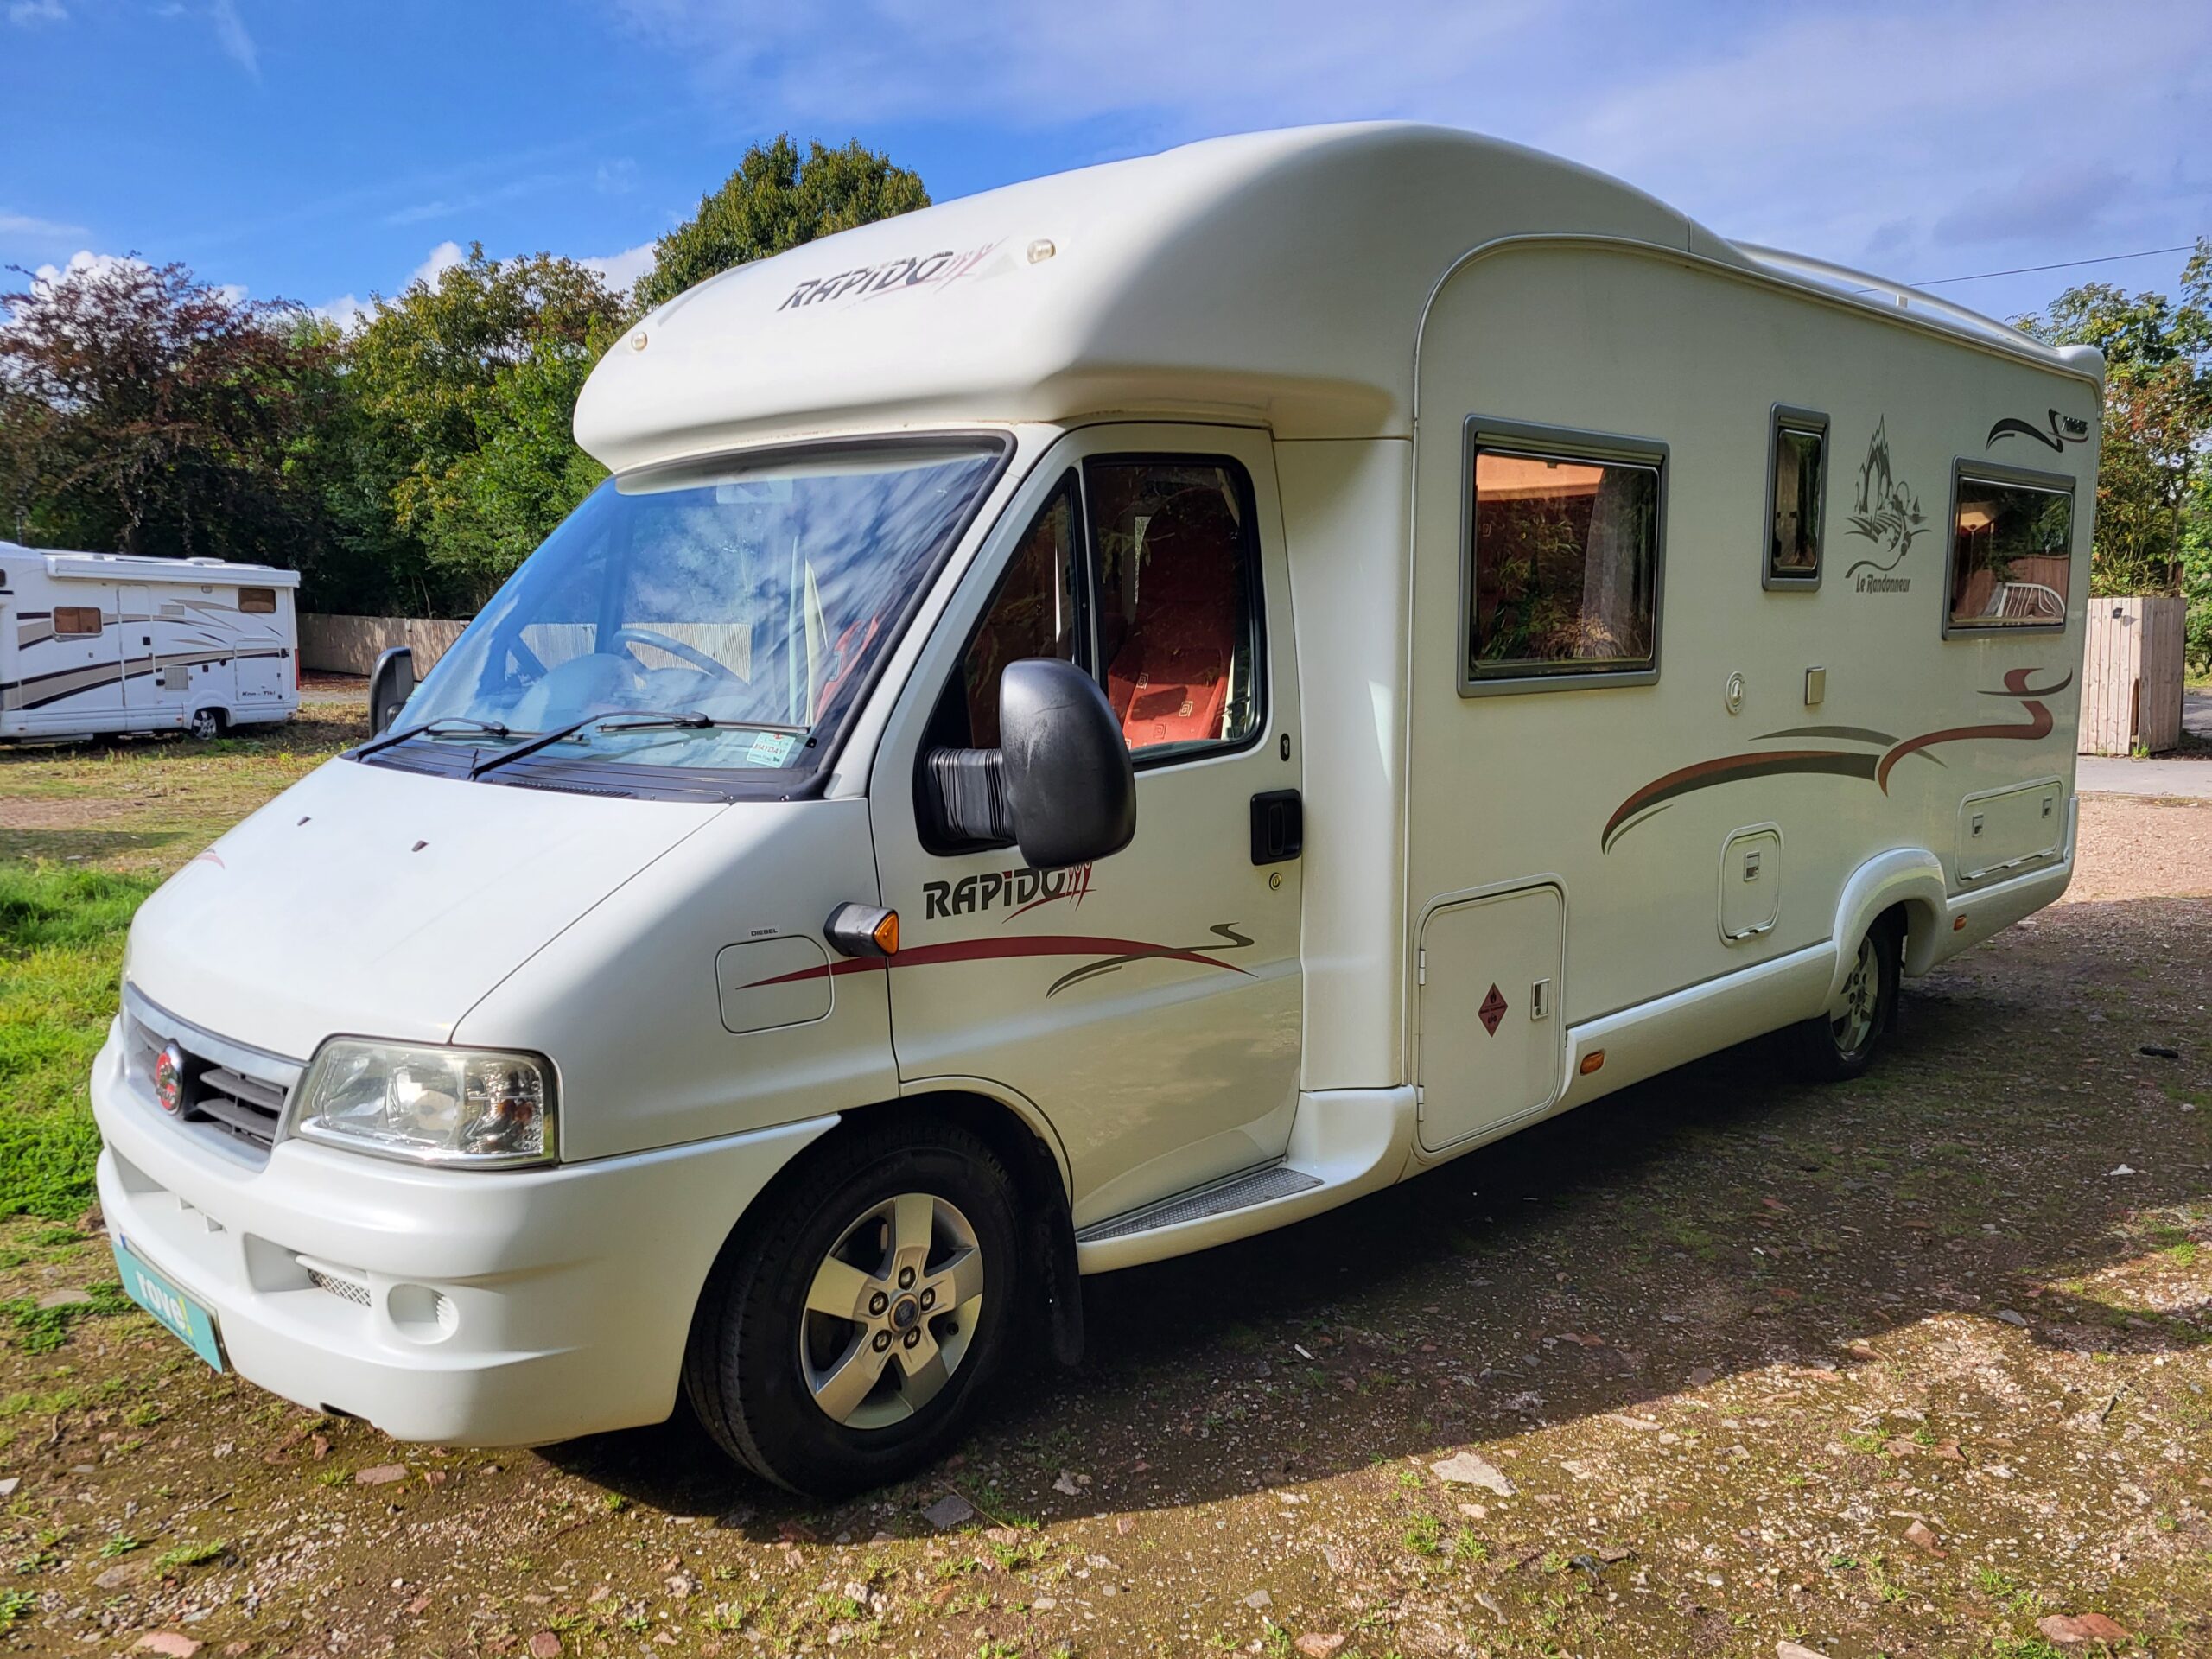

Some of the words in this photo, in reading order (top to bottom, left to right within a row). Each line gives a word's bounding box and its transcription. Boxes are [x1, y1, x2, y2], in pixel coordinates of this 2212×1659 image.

[1856, 574, 1866, 593] Le
[1866, 574, 1911, 594] Randonneur
[750, 928, 779, 937] DIESEL
